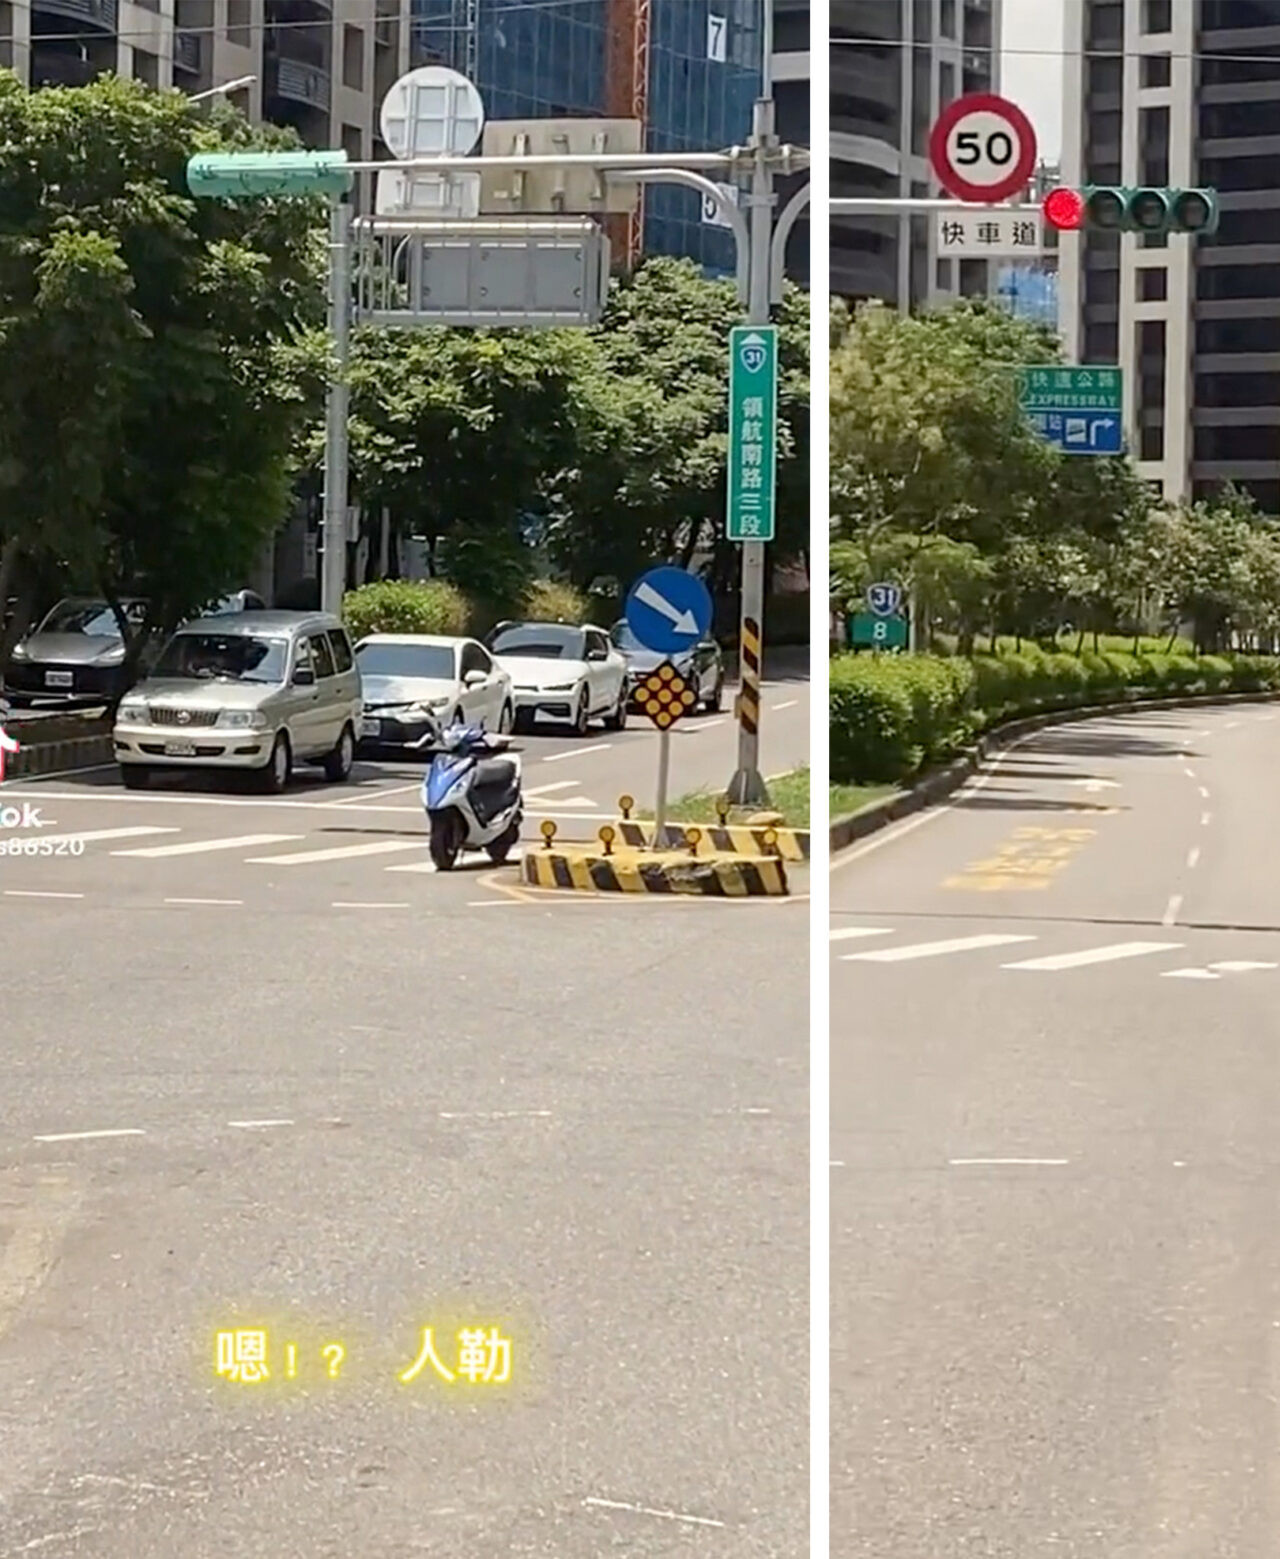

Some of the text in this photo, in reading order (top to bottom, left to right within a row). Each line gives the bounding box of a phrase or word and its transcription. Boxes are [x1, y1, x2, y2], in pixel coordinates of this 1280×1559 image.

[956, 131, 1012, 166] 50
[942, 221, 1036, 246] 快車道
[746, 351, 761, 363] 31
[739, 396, 764, 536] 領航南路三段
[873, 587, 895, 607] 31
[873, 621, 887, 640] 8
